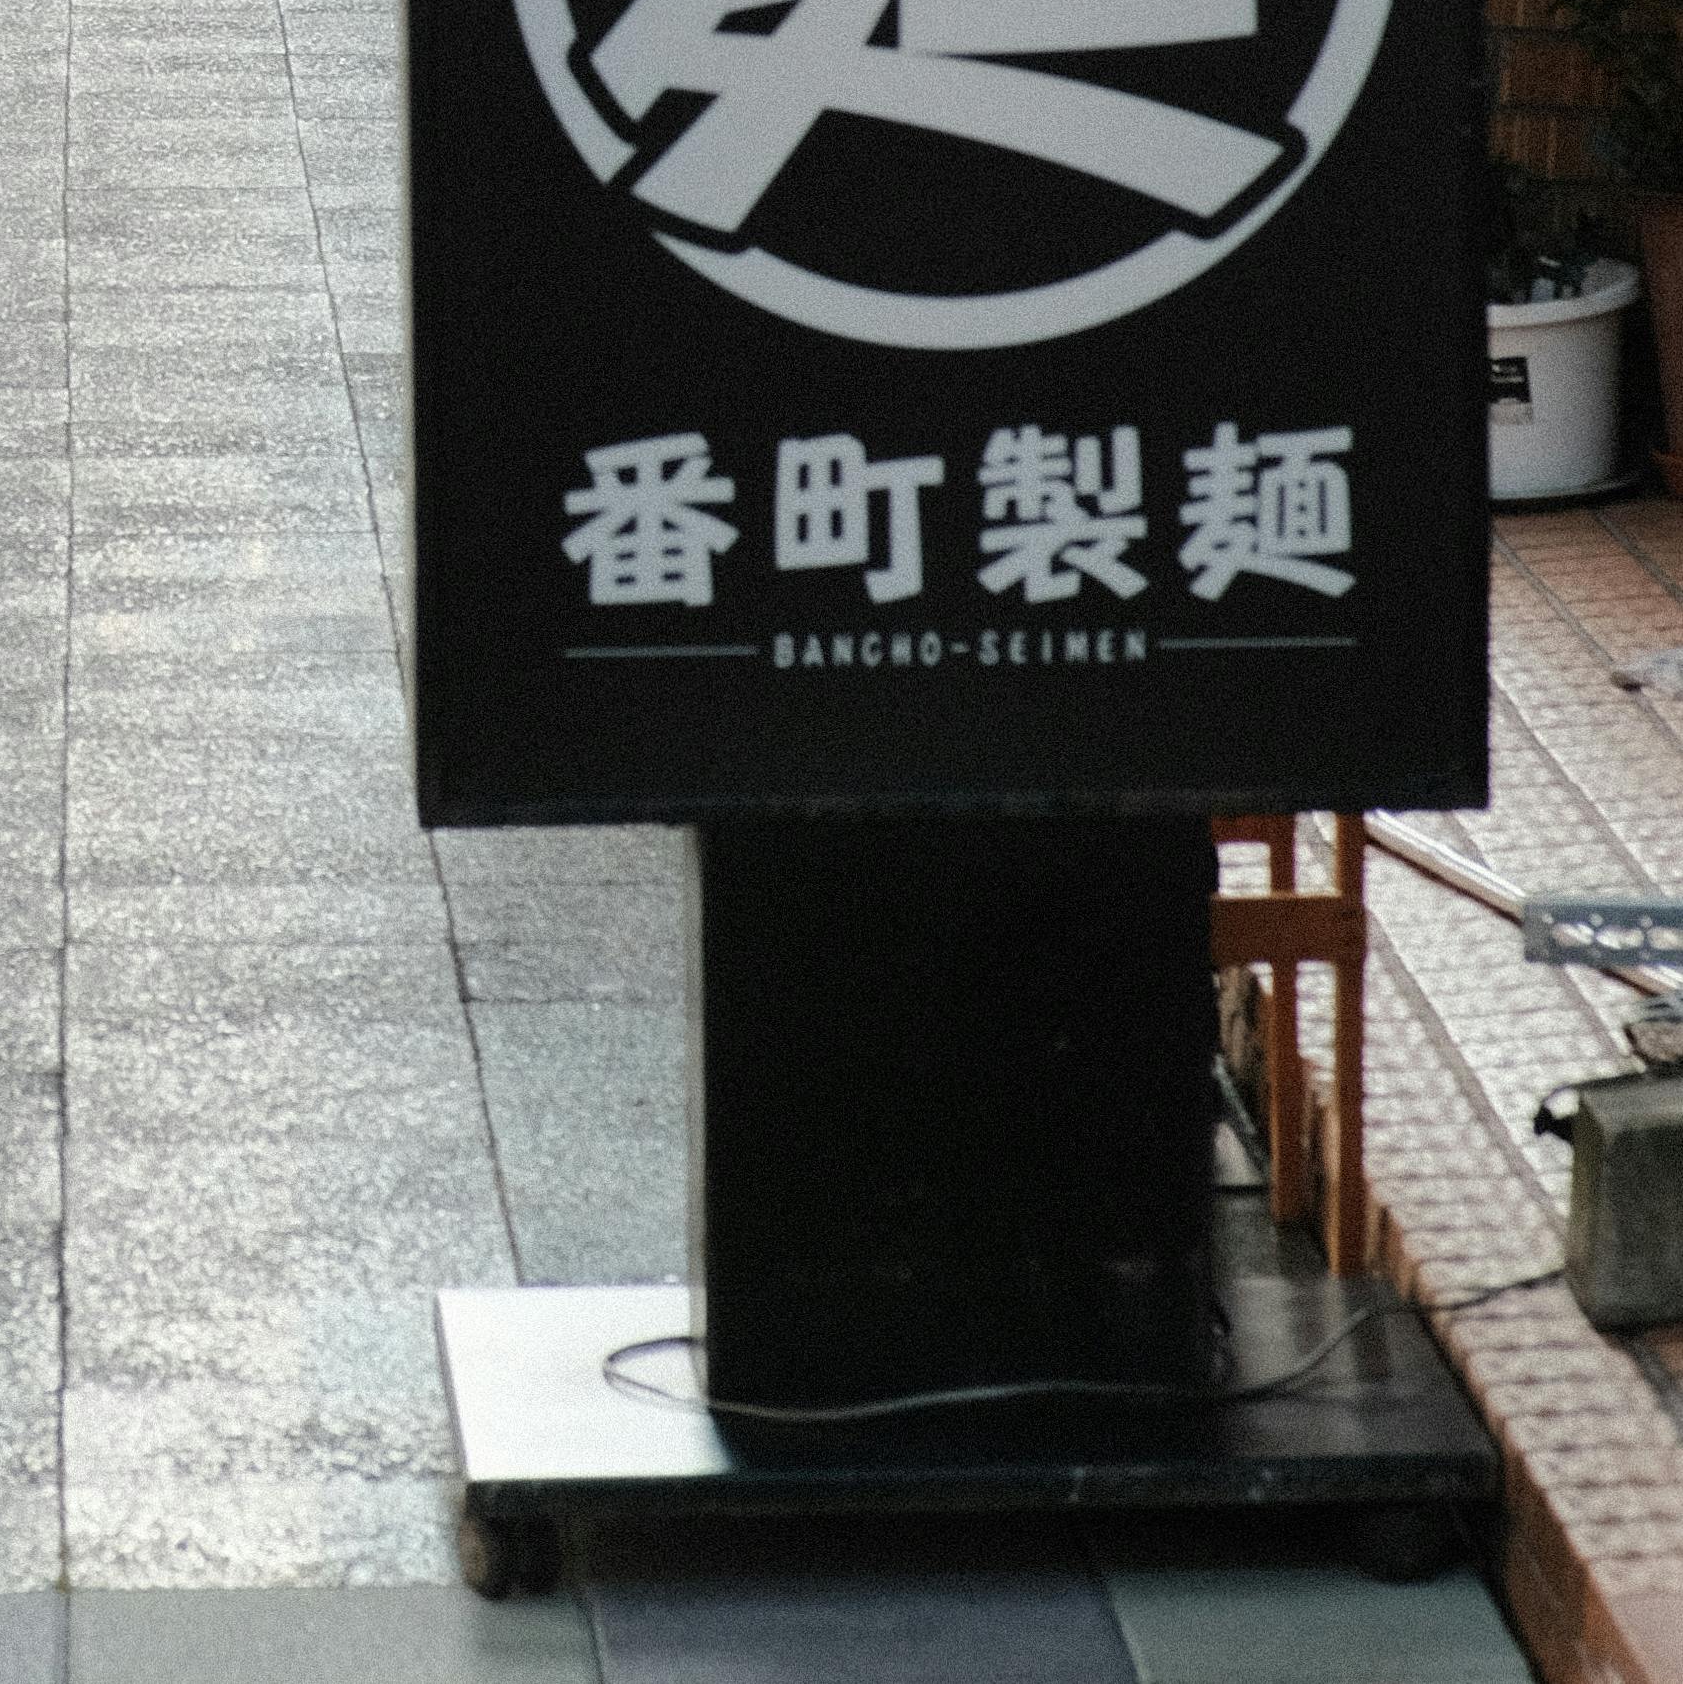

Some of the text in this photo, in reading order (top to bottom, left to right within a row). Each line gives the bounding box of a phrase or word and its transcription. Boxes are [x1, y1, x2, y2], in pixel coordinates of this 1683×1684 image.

[561, 421, 1357, 608] 番町製麺
[770, 627, 1150, 671] BANCHO-SEIMEN
